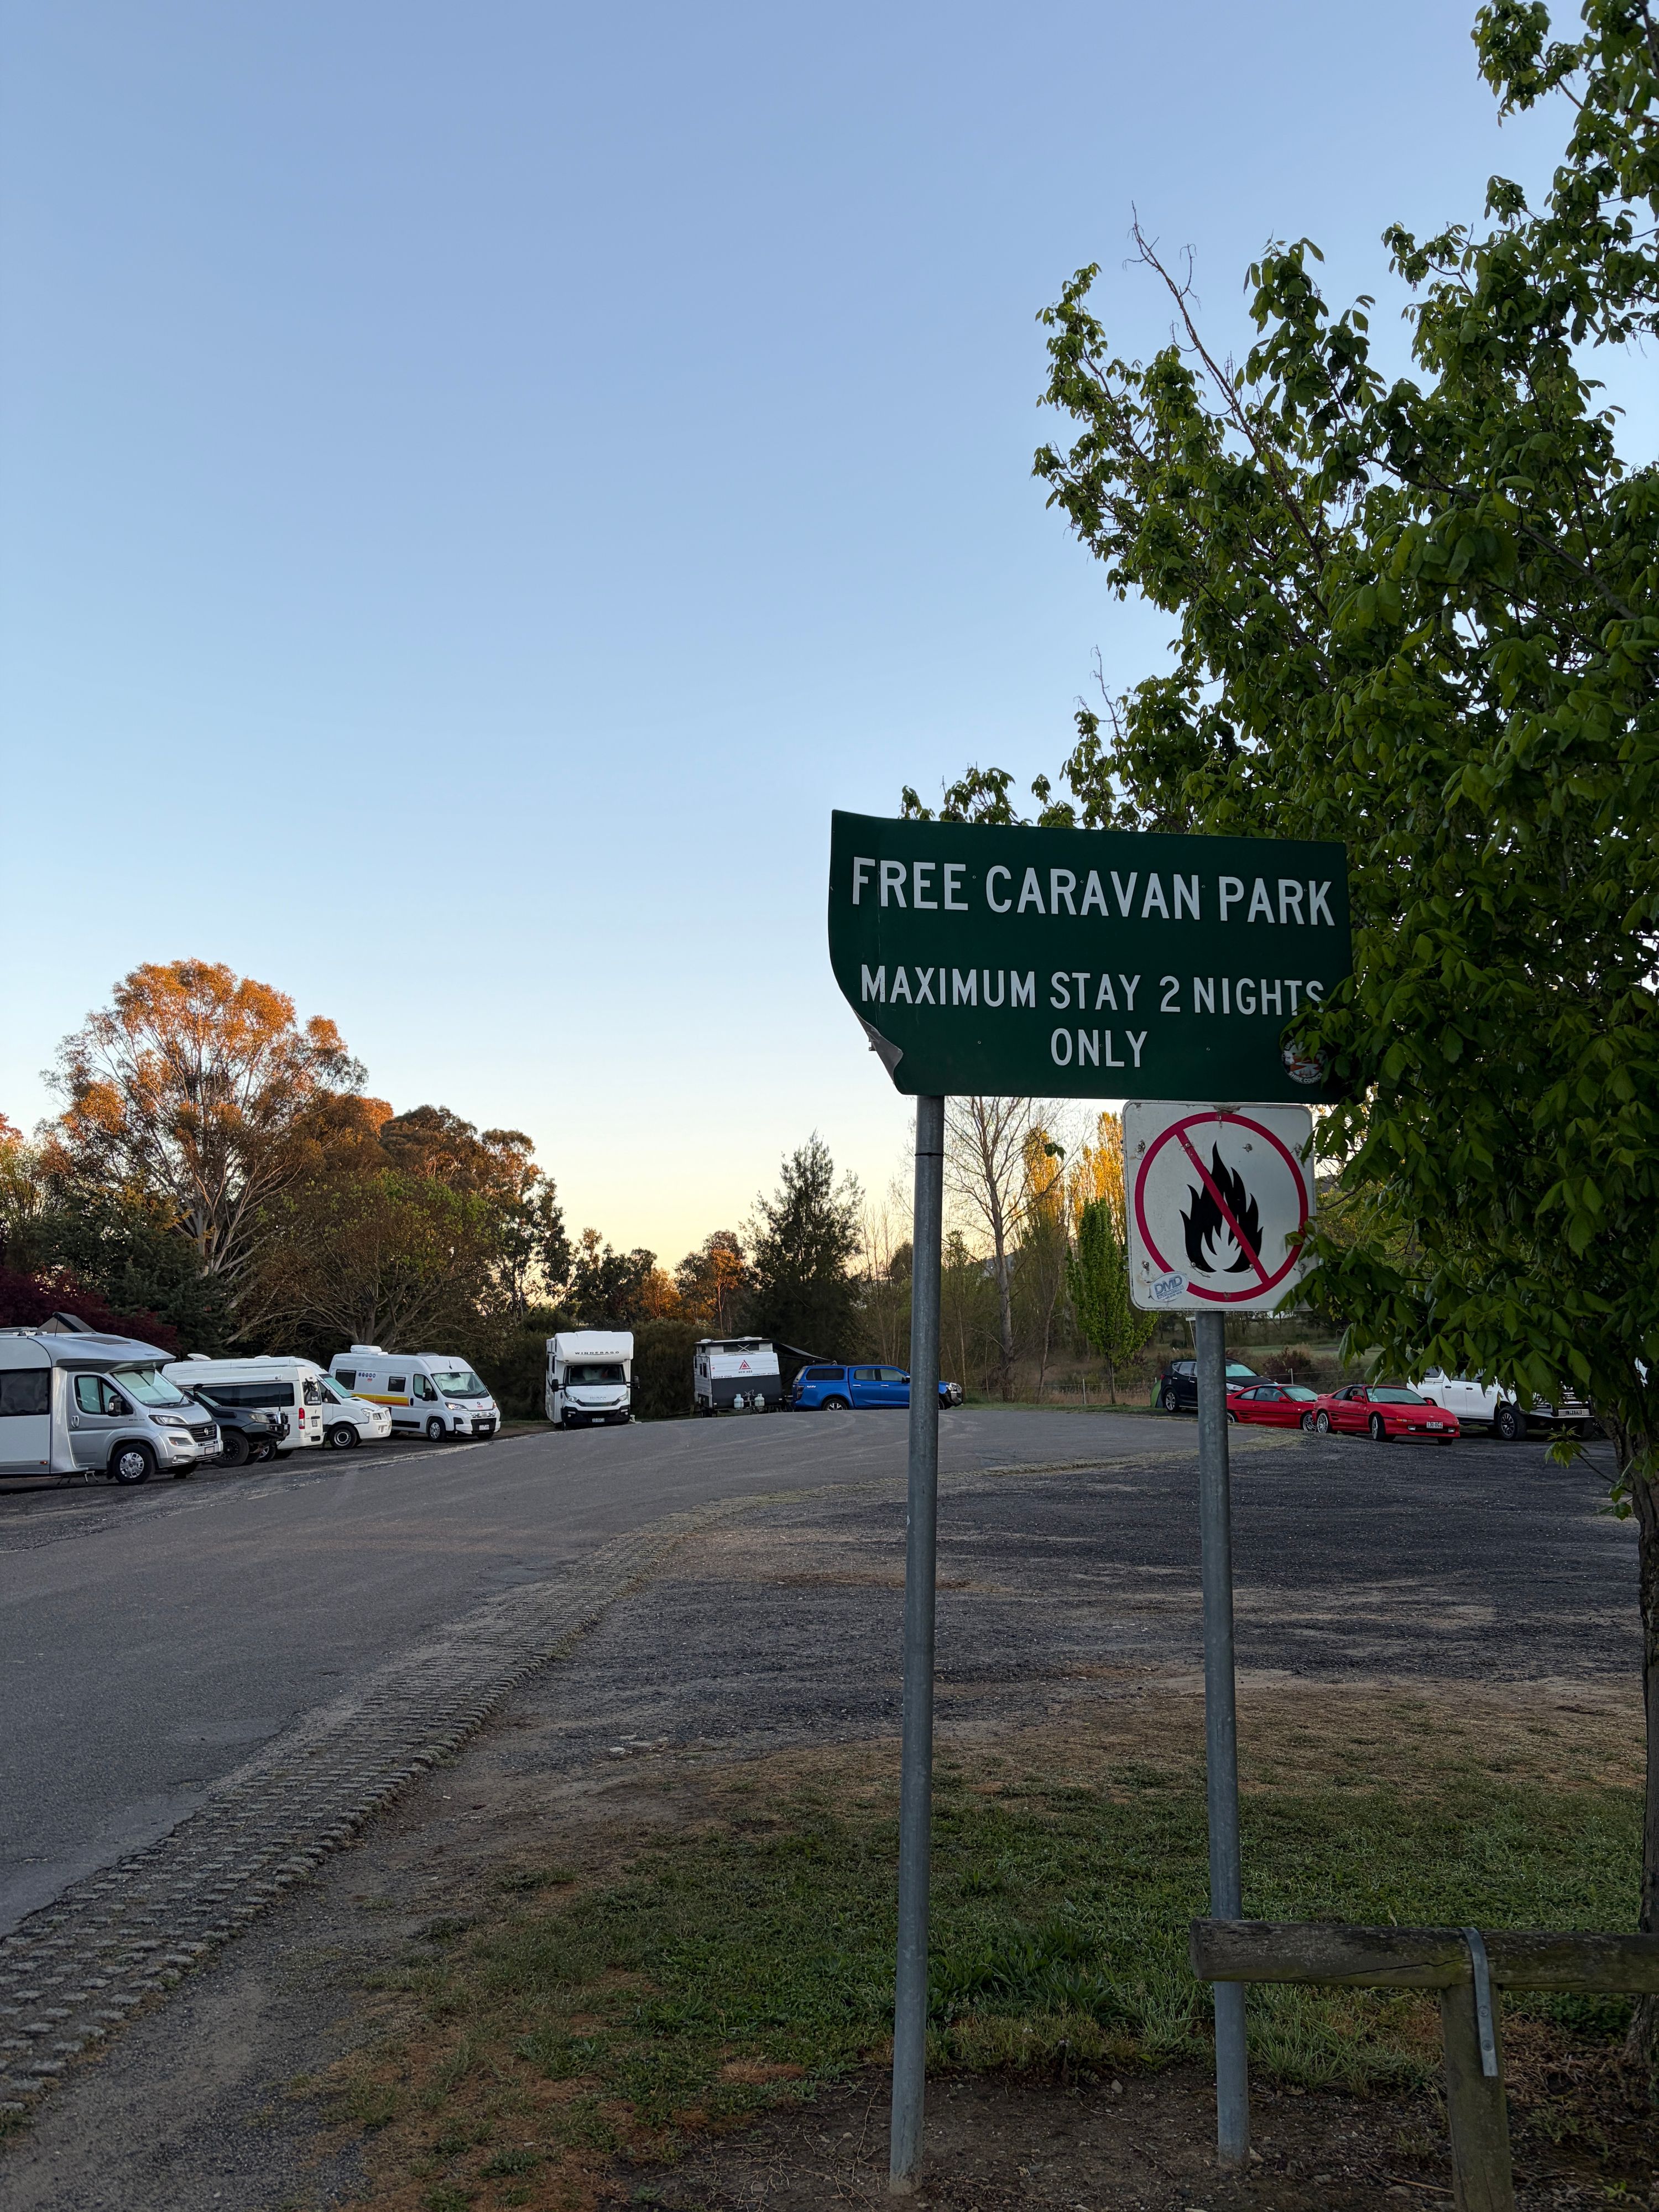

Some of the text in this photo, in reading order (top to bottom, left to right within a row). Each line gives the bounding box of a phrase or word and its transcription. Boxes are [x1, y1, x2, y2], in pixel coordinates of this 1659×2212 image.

[852, 857, 1335, 926] FREE CARAVAN PARK
[861, 964, 1324, 1015] MAXIMUM STAY 2 NIGHTS
[1051, 1028, 1148, 1067] ONLY
[1154, 1275, 1182, 1295] DMD
